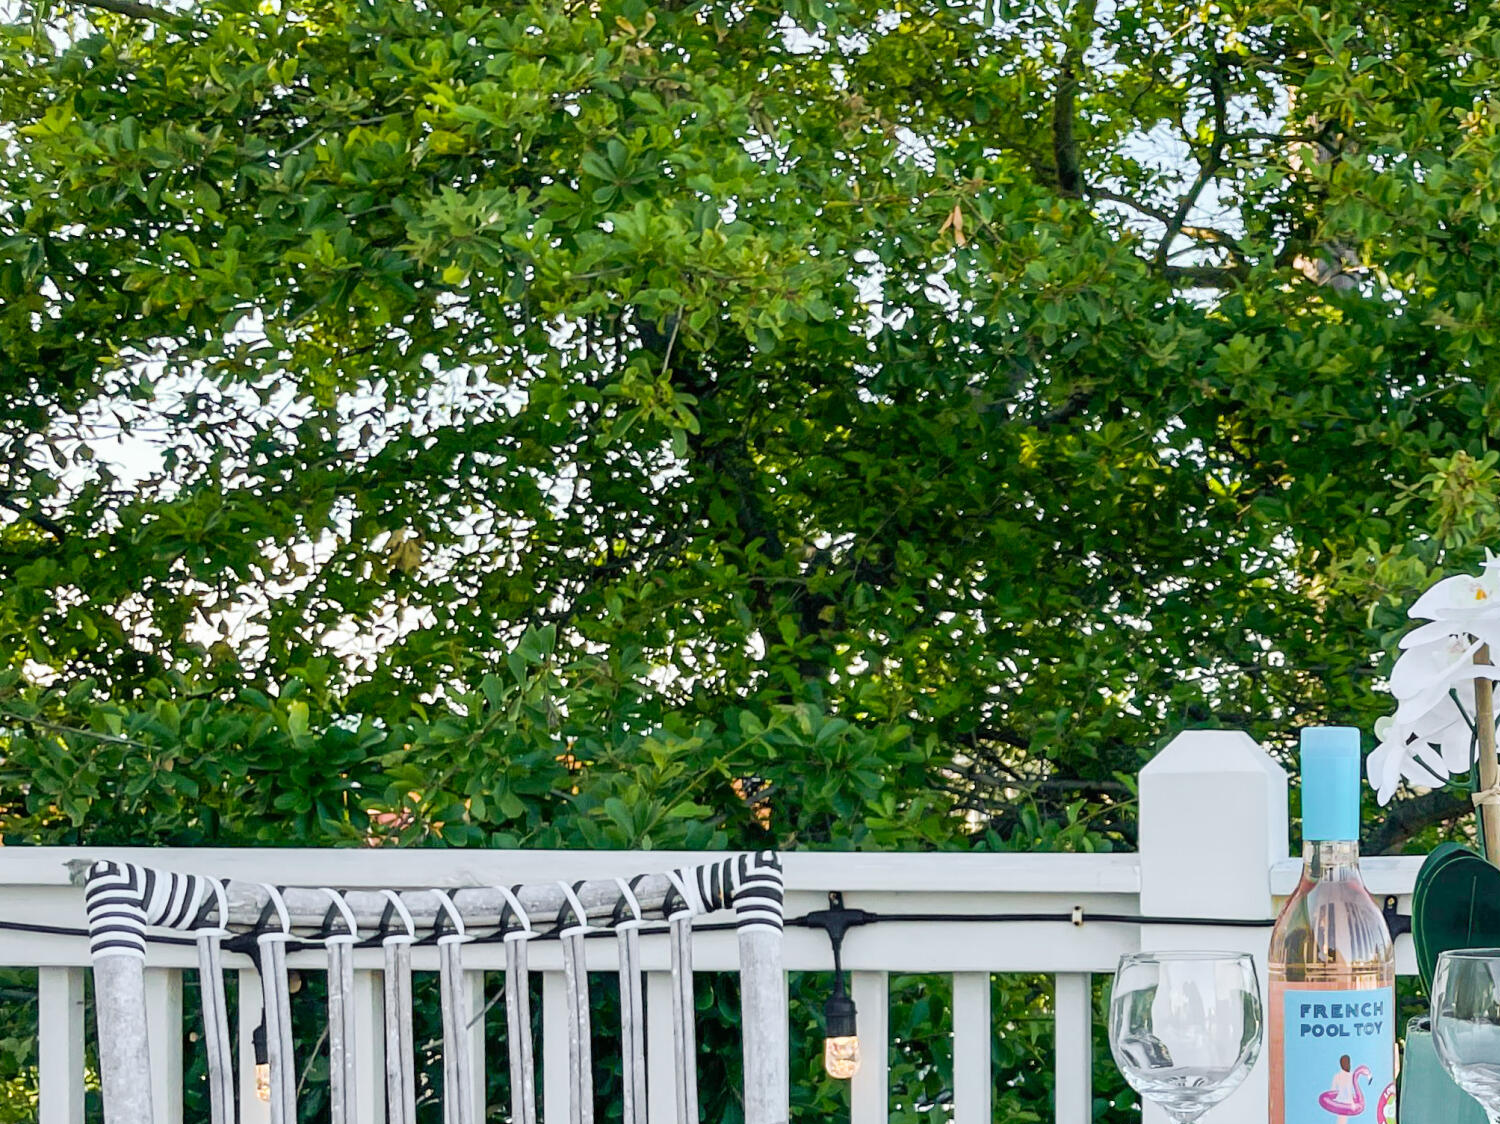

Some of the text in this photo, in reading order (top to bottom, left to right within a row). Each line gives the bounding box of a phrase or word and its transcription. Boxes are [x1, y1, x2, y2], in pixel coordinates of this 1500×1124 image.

[1300, 1001, 1384, 1018] FRENCH
[1300, 1021, 1383, 1038] POOL TOY
